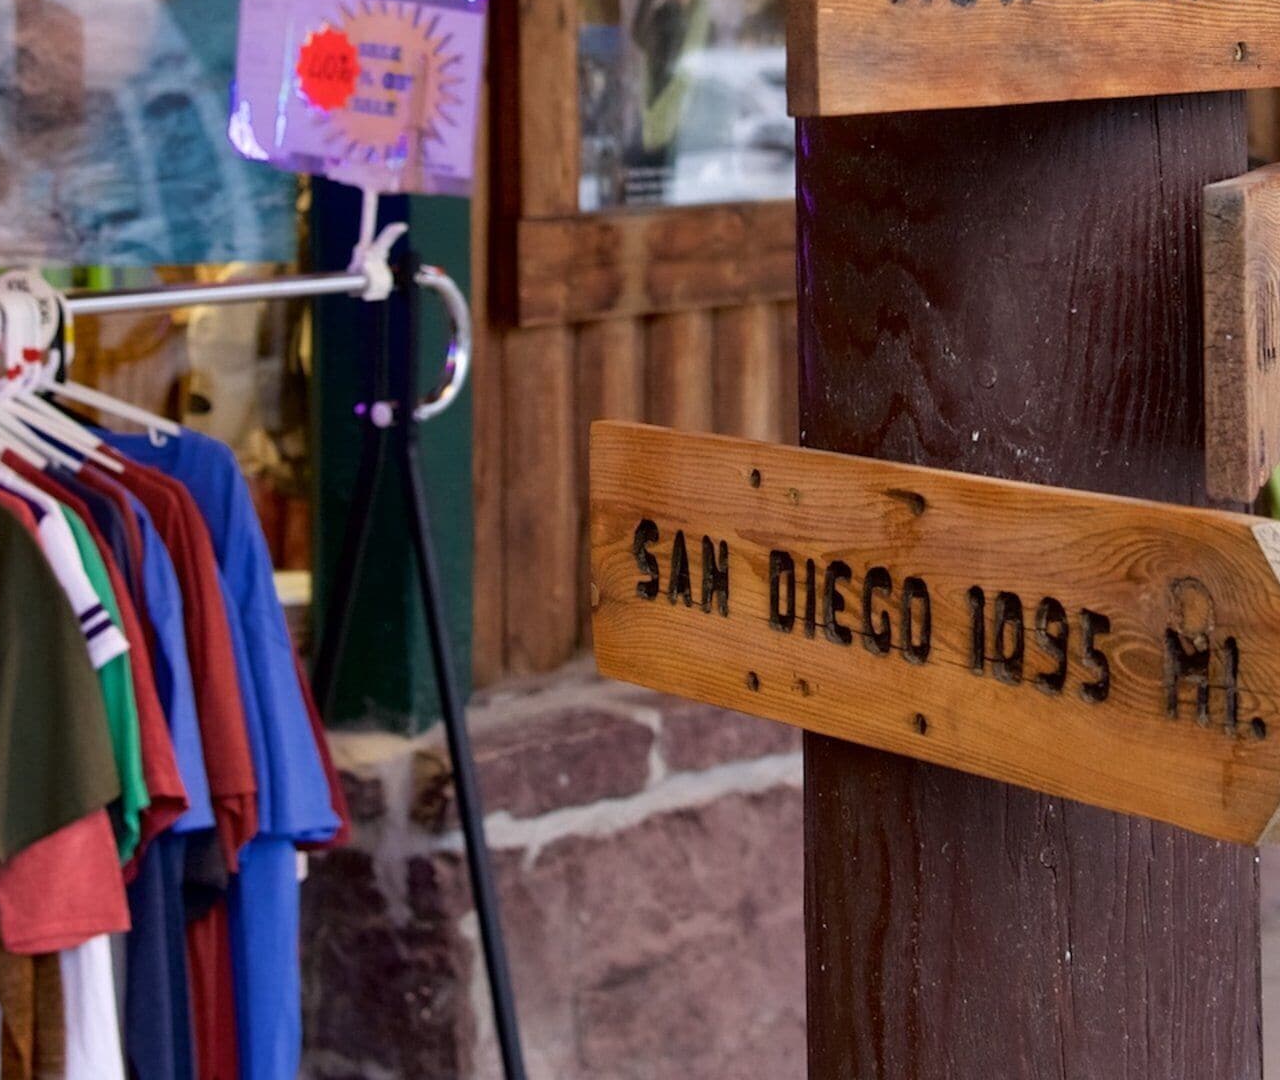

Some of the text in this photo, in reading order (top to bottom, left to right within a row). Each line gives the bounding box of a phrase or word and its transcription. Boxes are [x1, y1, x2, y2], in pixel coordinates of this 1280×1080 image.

[631, 518, 1267, 739] SAN DIEGO 1095 MI.
